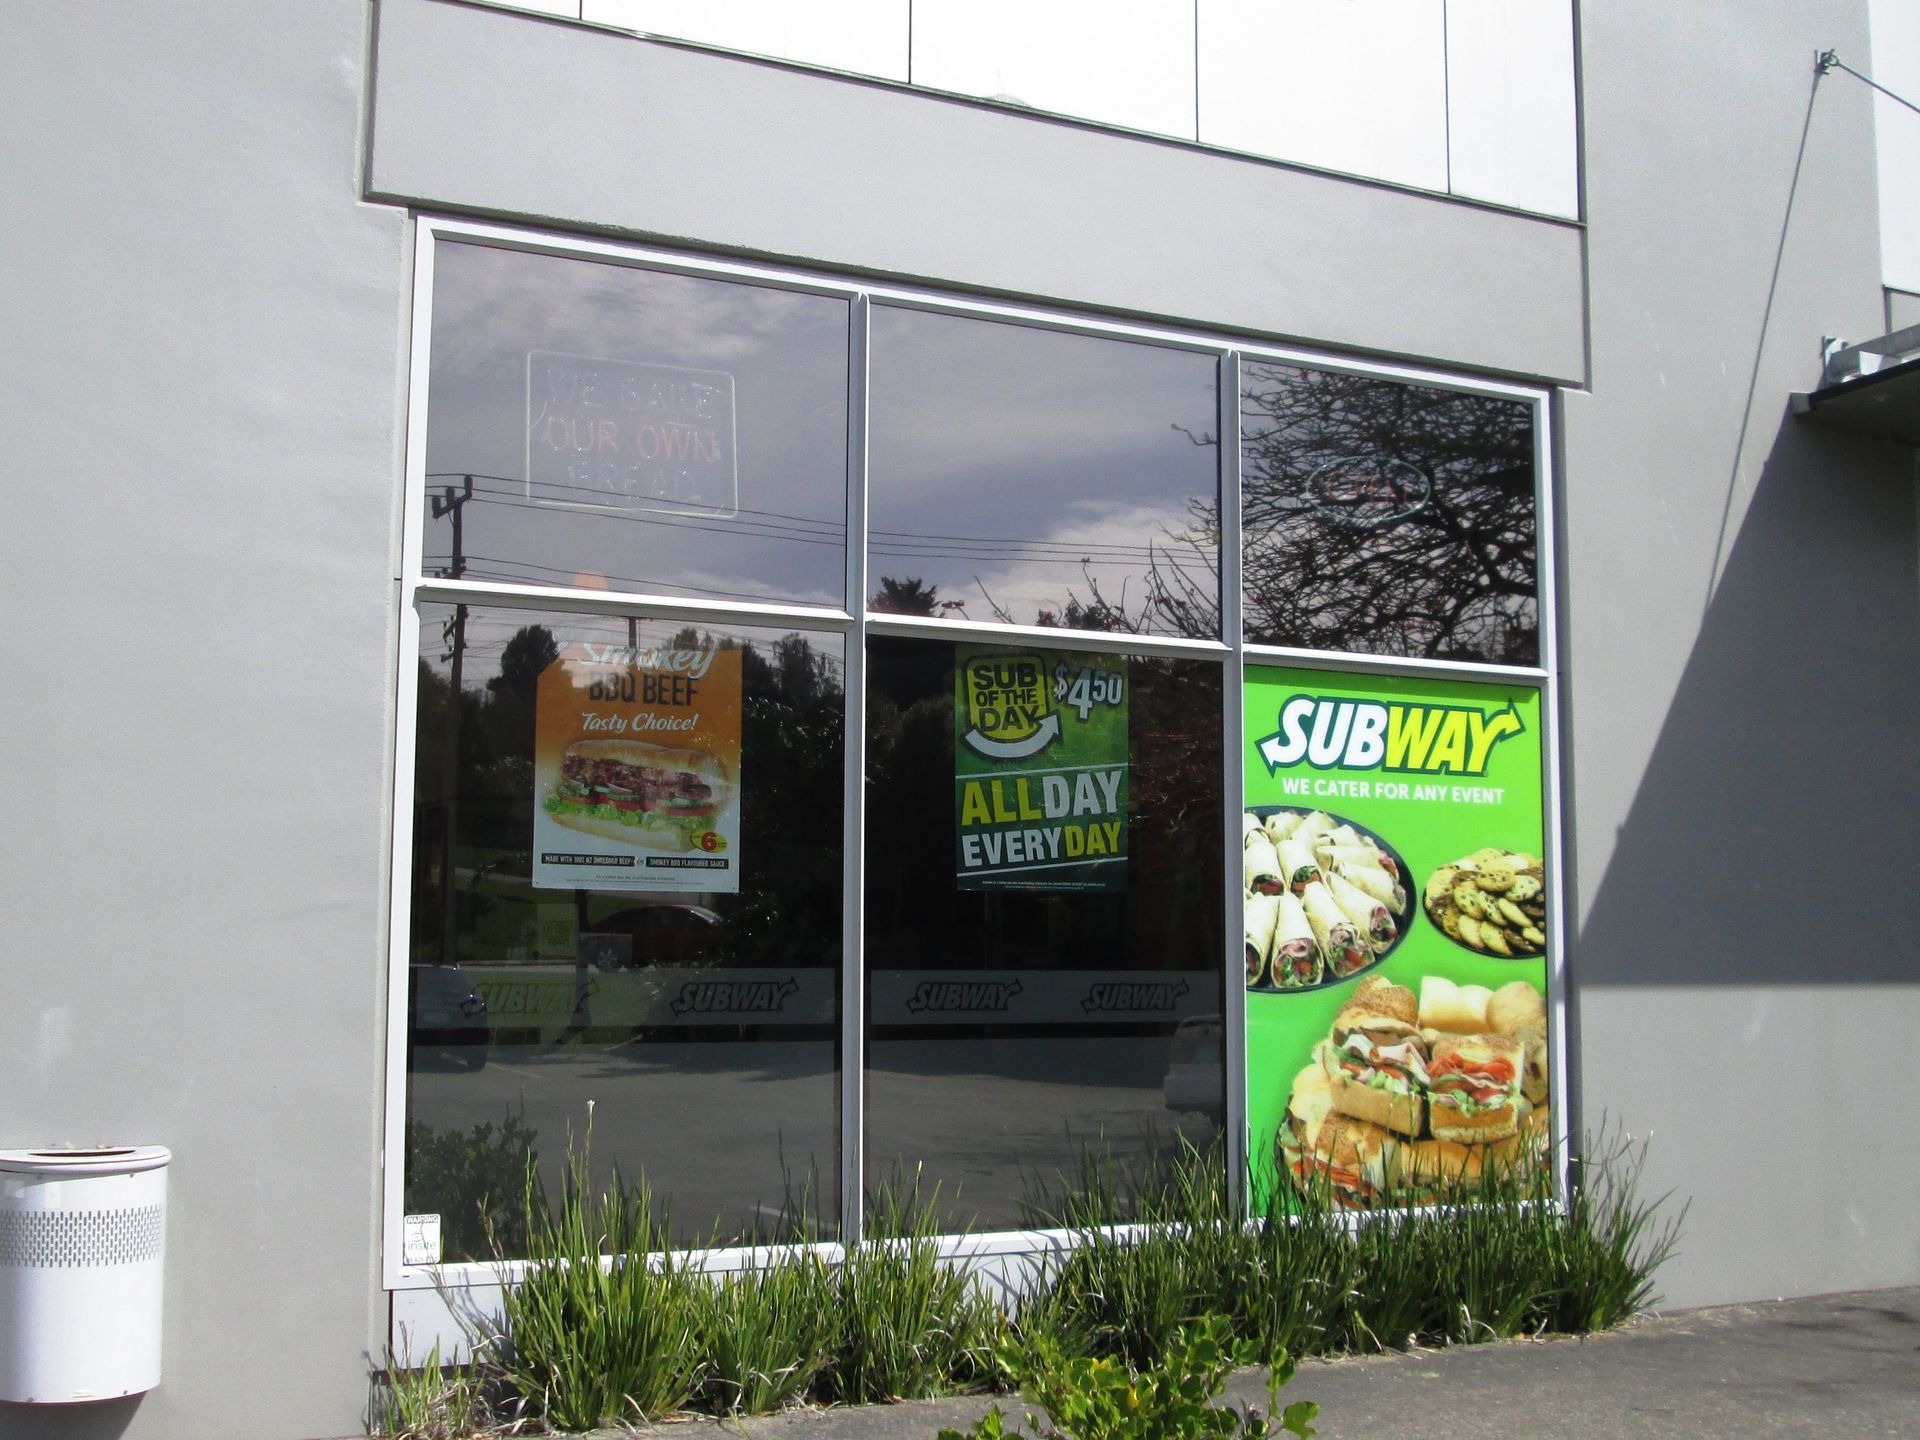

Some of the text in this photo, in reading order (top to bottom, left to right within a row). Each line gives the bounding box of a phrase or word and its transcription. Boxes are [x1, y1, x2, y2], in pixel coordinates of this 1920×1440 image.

[542, 415, 619, 452] OUR
[576, 642, 715, 679] Smokey
[973, 662, 1038, 690] SUB
[588, 671, 700, 706] BBQ BEEF
[976, 688, 1038, 707] OF THE
[582, 712, 699, 733] Tasty Choice!
[978, 704, 1040, 731] DAY
[1257, 696, 1524, 775] SUBWAY
[1282, 777, 1505, 804] WE CATER FOR ANY EVENT
[670, 977, 799, 1015] SUBWAY
[906, 978, 1024, 1015] SUBWAY
[1081, 979, 1189, 1014] SUBWAY
